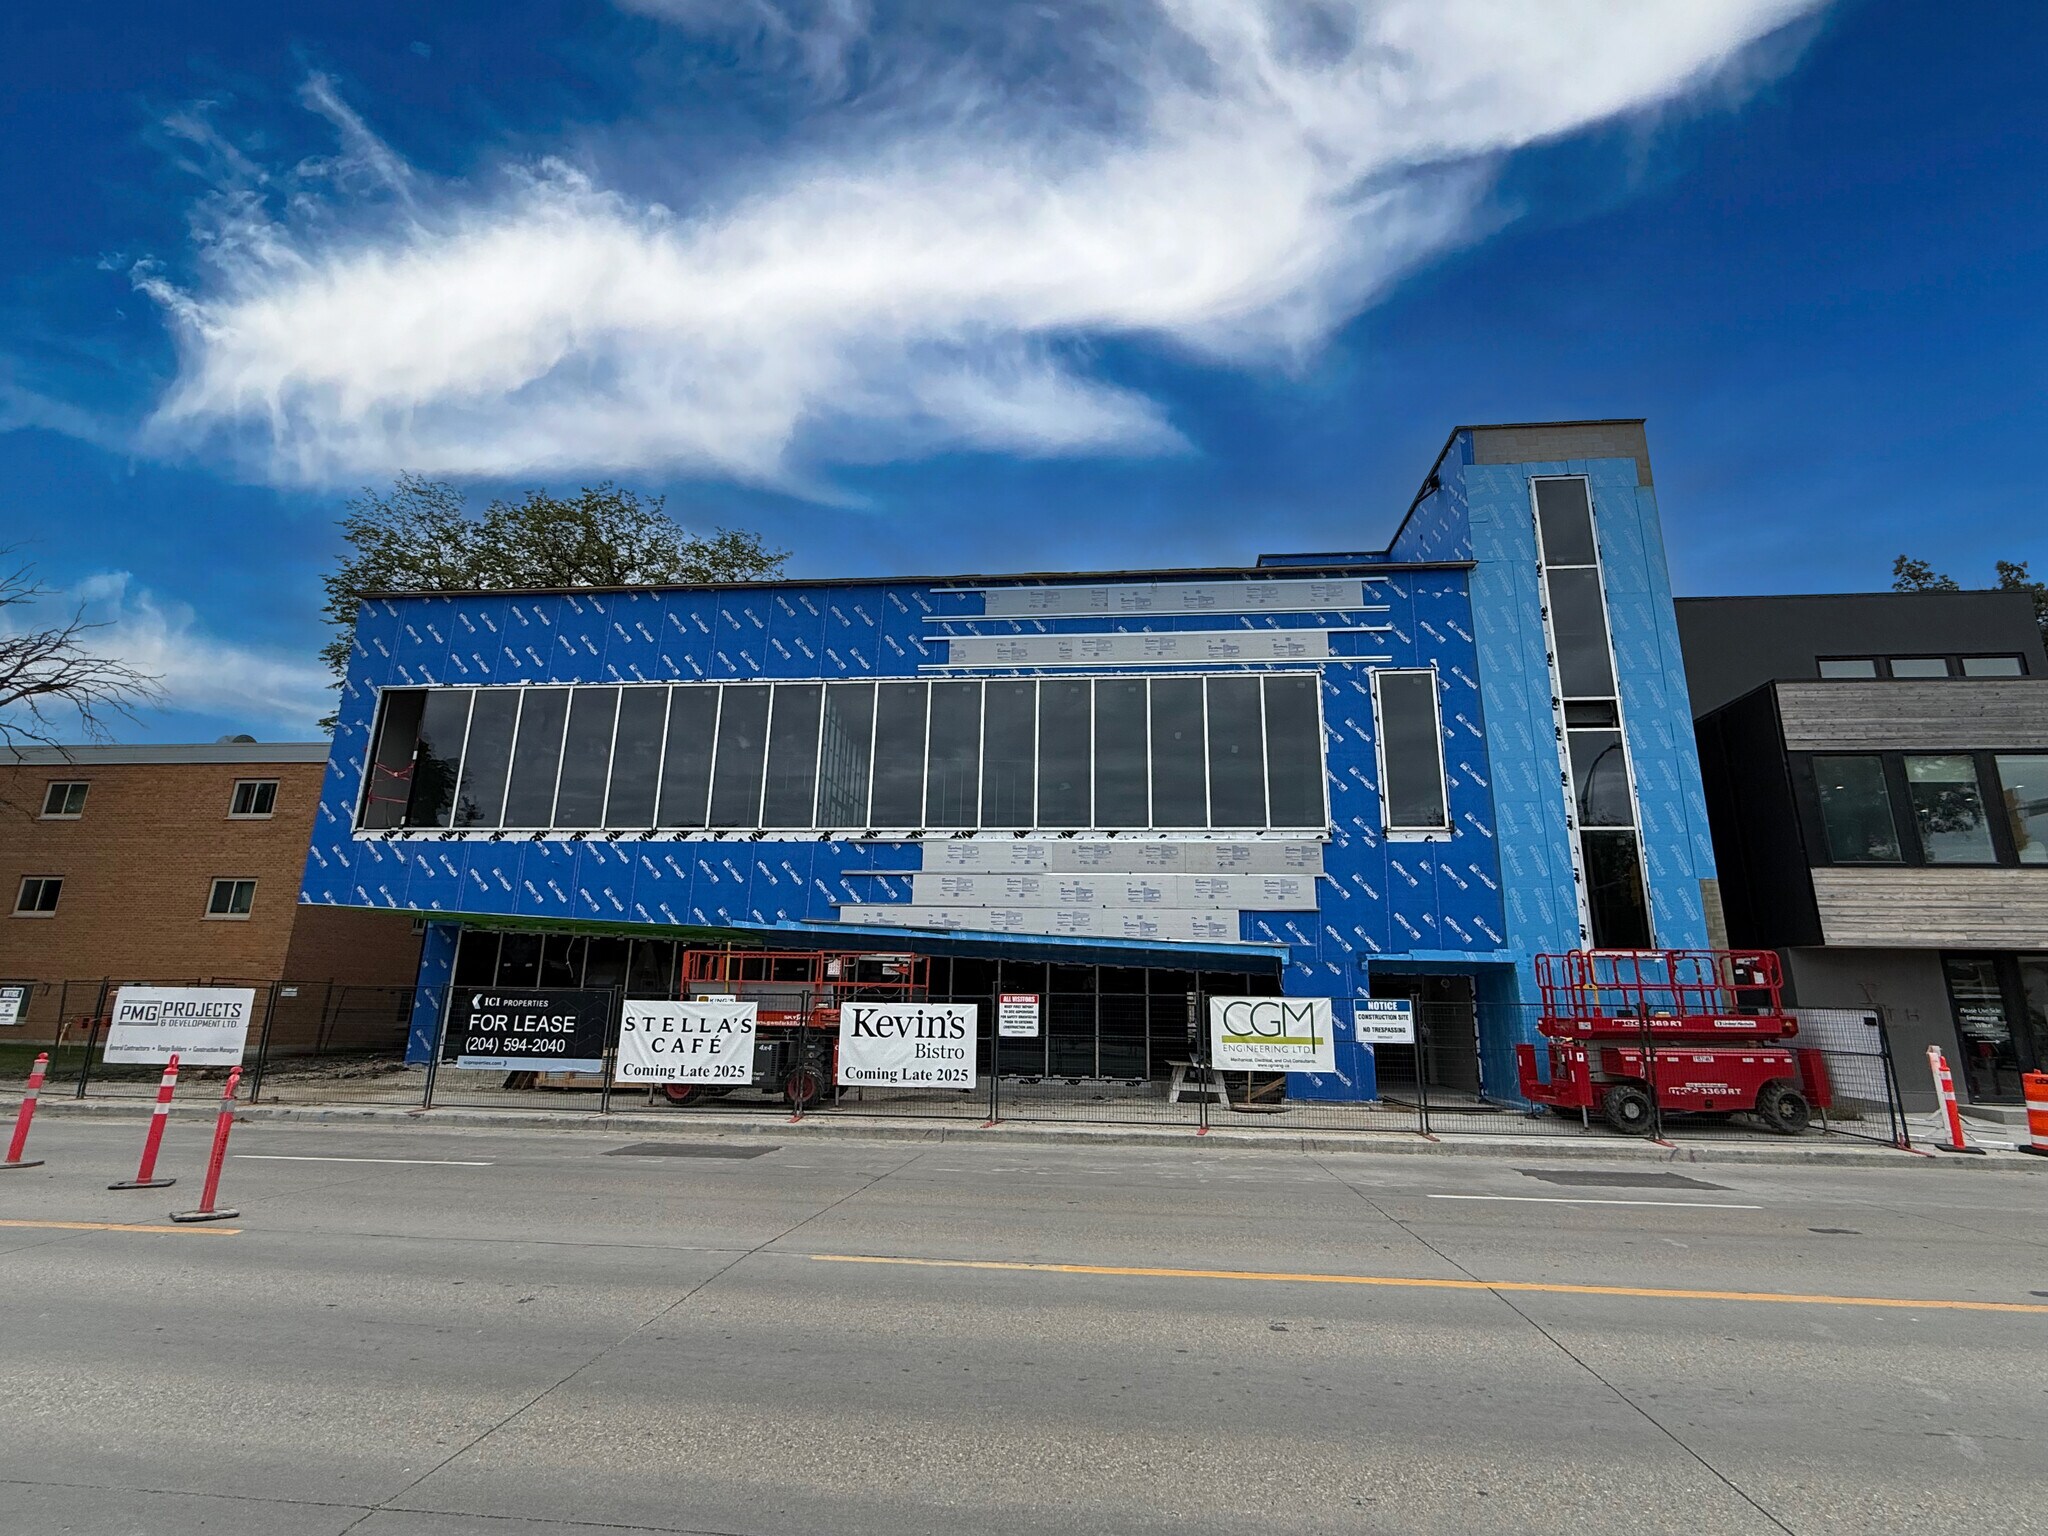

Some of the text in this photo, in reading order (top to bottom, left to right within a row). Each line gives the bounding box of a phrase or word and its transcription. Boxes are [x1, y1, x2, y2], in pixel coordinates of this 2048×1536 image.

[119, 1002, 242, 1021] PMG PROJECTS
[484, 997, 549, 1008] ICI PROPERTIES
[1367, 1001, 1398, 1011] NOTICE
[160, 1019, 239, 1028] & DEVELOPMENT LTD.
[468, 1014, 576, 1033] FOR LEASE
[624, 1016, 752, 1034] STELLA'S
[851, 1008, 965, 1040] Kevin's
[1223, 1001, 1316, 1055] CGM
[465, 1036, 566, 1054] (204) 594-2040
[651, 1035, 722, 1054] CAFÉ
[915, 1042, 965, 1060] Bistro
[1222, 1045, 1312, 1054] ENGINEERING LTD.
[623, 1063, 676, 1080] Coming
[680, 1064, 710, 1078] Late
[714, 1065, 745, 1078] 2025
[845, 1066, 969, 1083] Coming Late 2025
[1700, 1087, 1727, 1095] 3369
